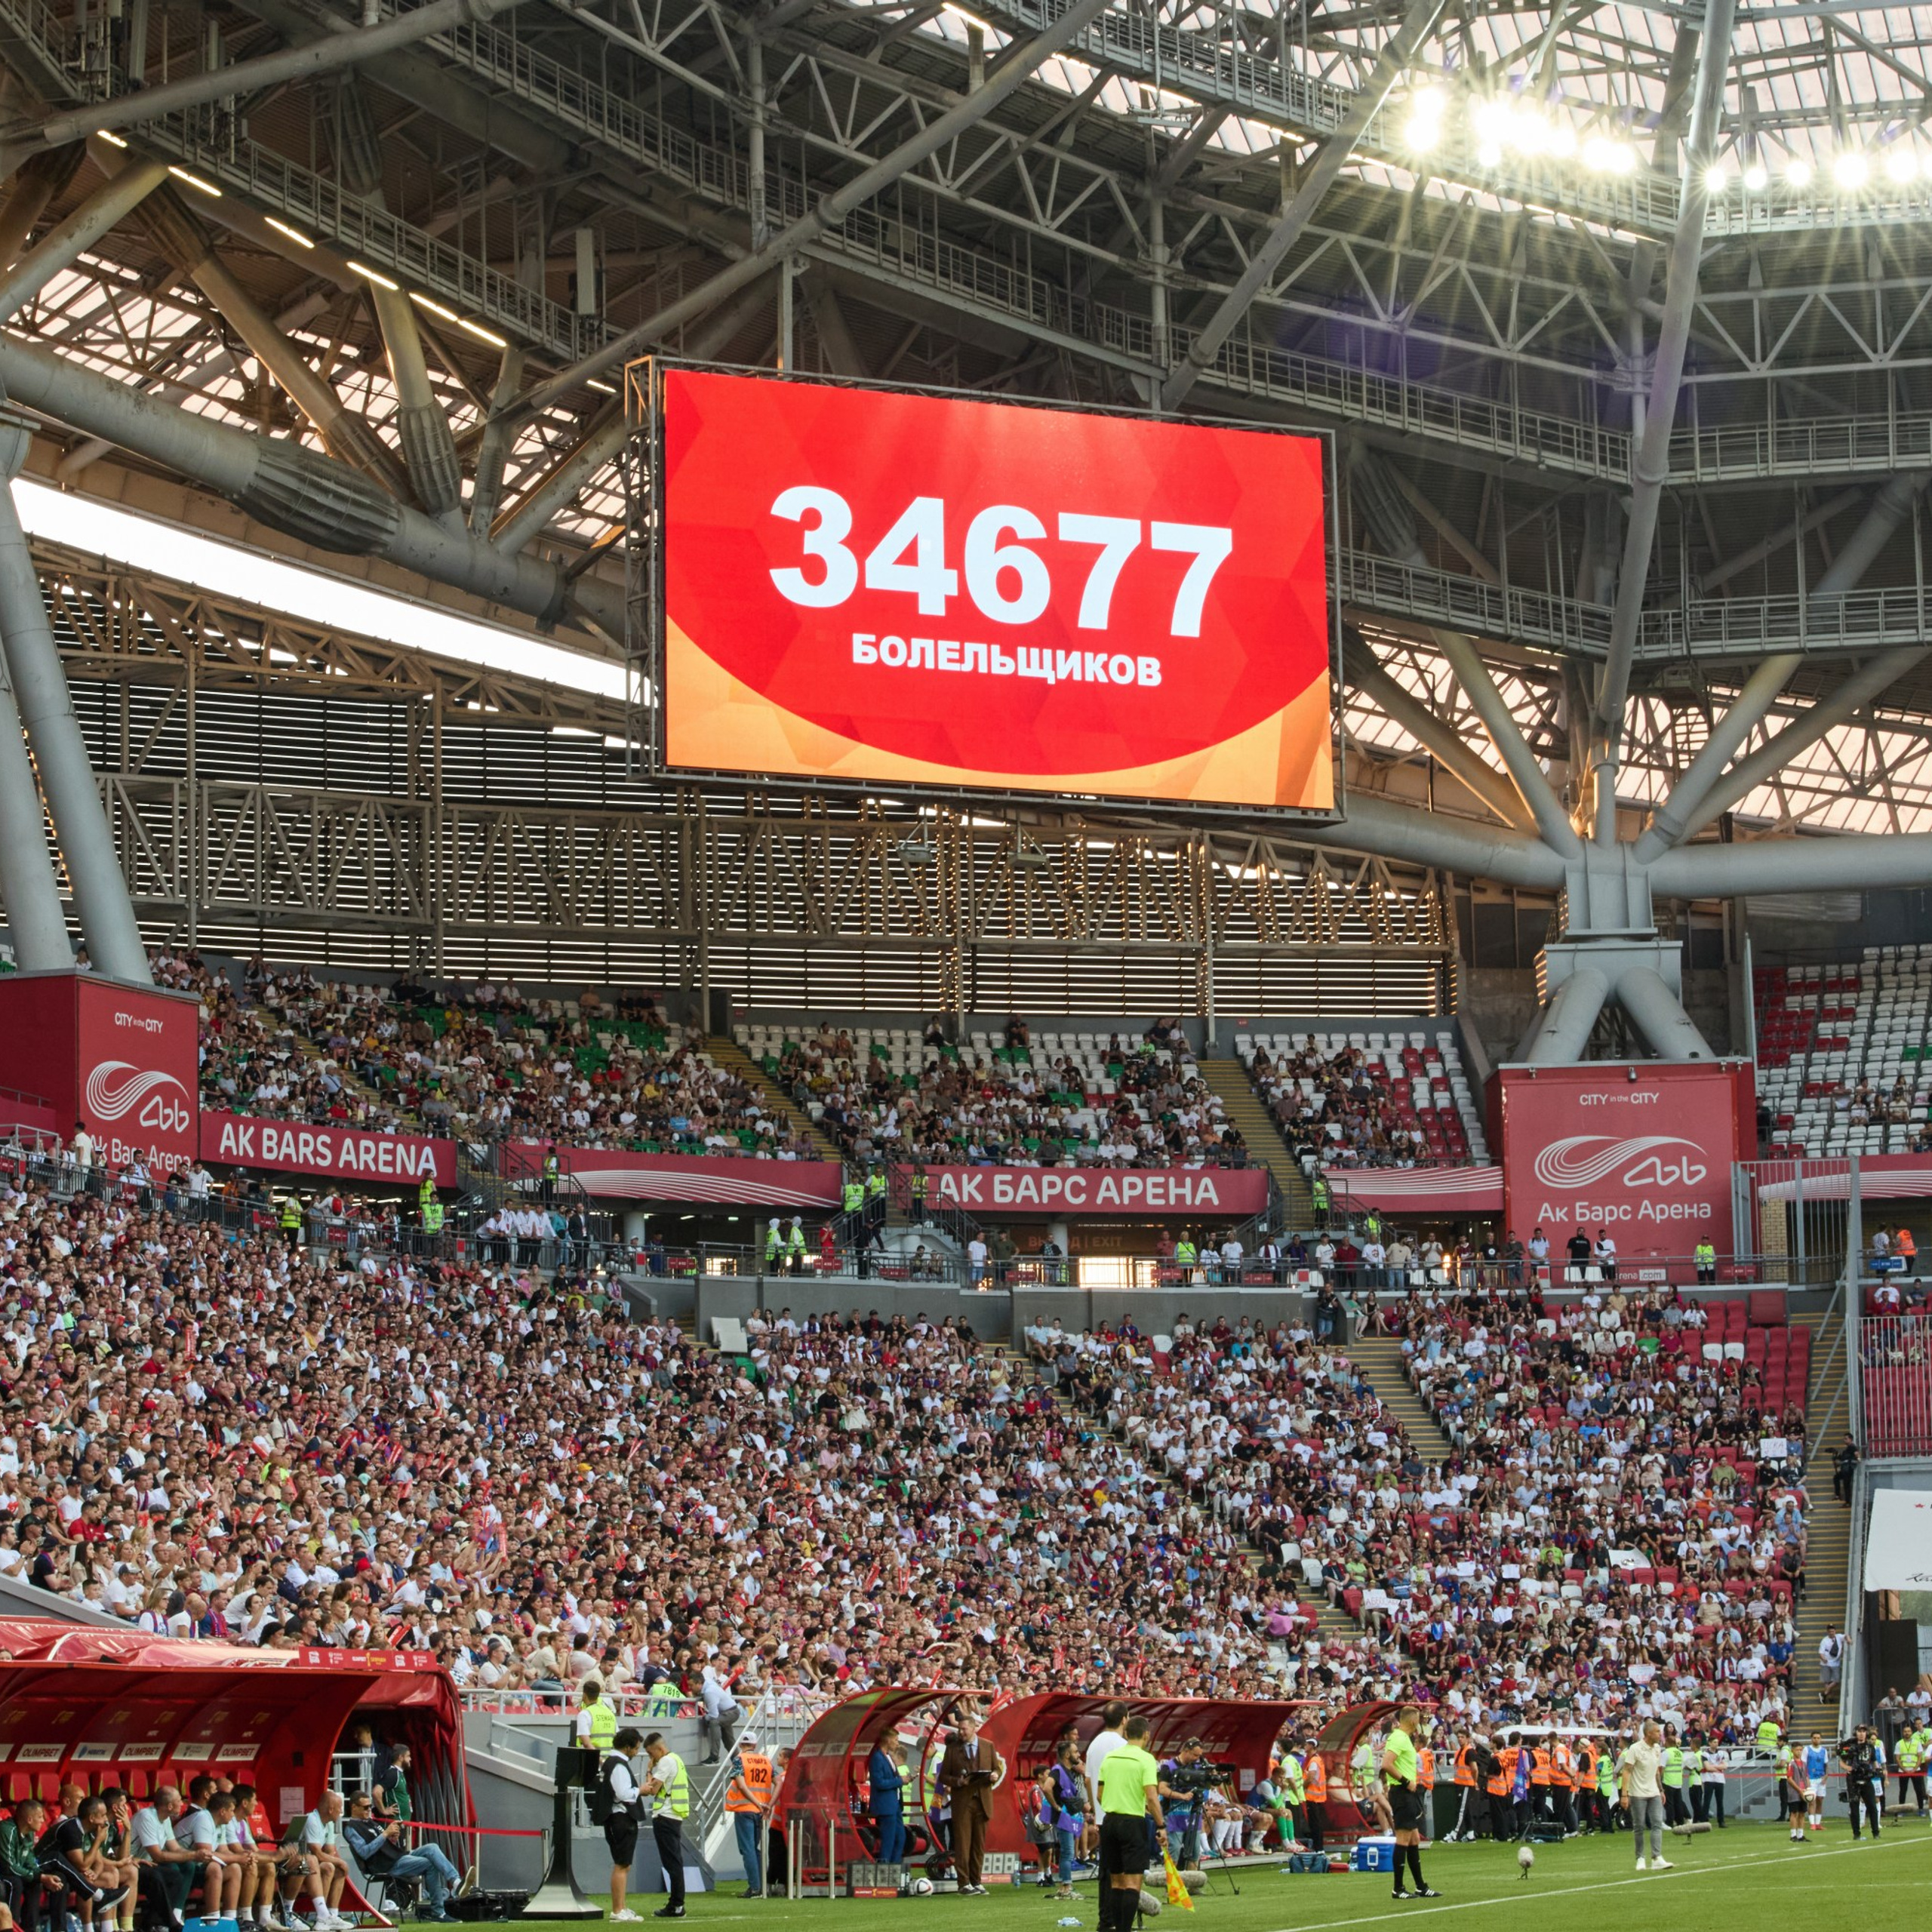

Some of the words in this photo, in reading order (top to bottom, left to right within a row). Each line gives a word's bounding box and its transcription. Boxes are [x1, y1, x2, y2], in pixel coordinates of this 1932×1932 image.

[769, 485, 1232, 638] 34677
[852, 633, 1162, 687] БОЛЕЛЬЩИКОВ
[115, 1012, 133, 1027] CITY
[145, 1019, 163, 1034] CITY
[1580, 1094, 1608, 1106] CITY
[1630, 1092, 1660, 1104] CITY
[112, 1138, 144, 1165] Bar
[220, 1122, 254, 1158] AK
[262, 1128, 332, 1167] BARS
[339, 1137, 437, 1177] ARENA
[937, 1173, 983, 1202] АК
[993, 1174, 1087, 1204] БАРС
[1096, 1176, 1220, 1206] АРЕНА
[1537, 1202, 1568, 1222] Ак
[1575, 1201, 1632, 1225] Барс
[1638, 1199, 1712, 1223] Арена
[1092, 1236, 1122, 1246] EXIT
[1641, 1271, 1662, 1280] .com
[663, 1685, 680, 1698] 7819
[22, 1748, 60, 1757] OLIMPBET
[125, 1747, 160, 1756] OLIMPBET
[222, 1747, 255, 1756] OLIMPBET
[750, 1768, 768, 1783] 182
